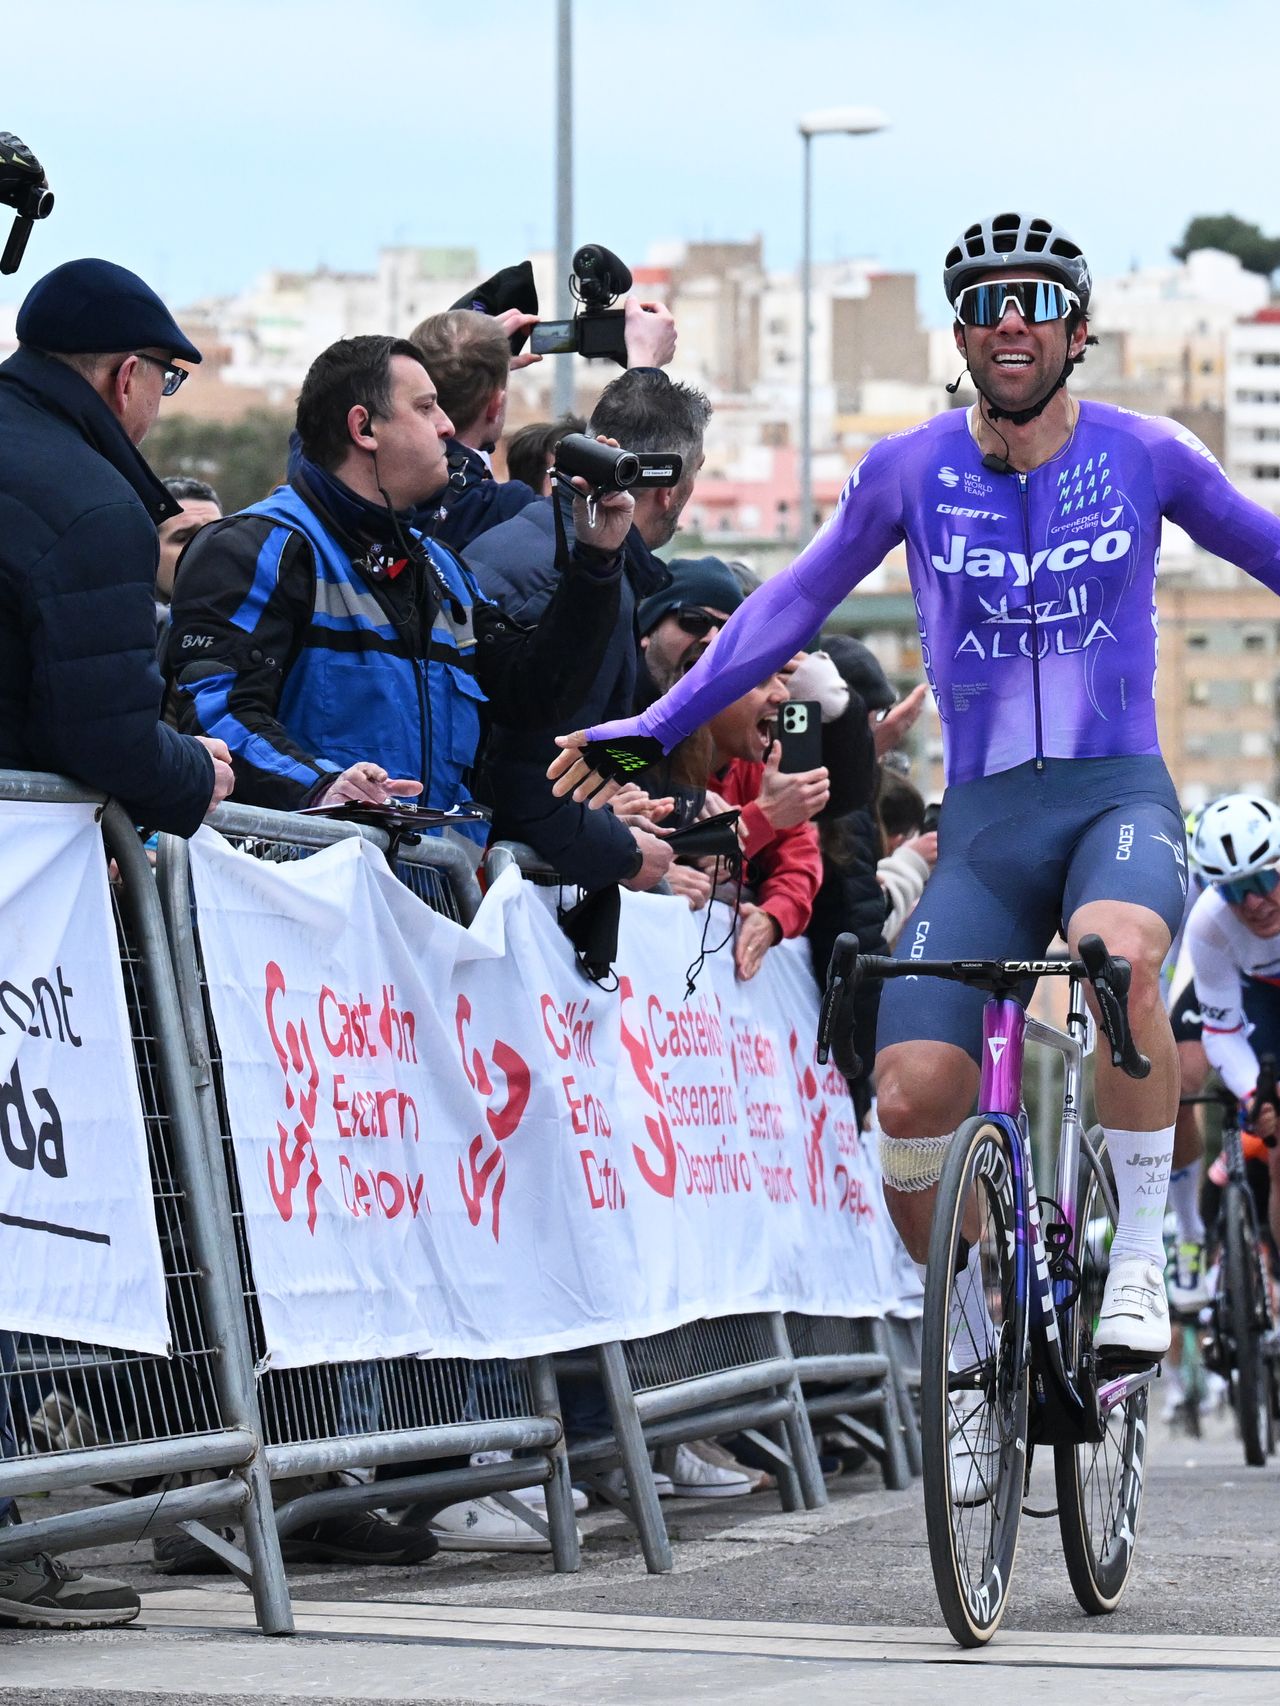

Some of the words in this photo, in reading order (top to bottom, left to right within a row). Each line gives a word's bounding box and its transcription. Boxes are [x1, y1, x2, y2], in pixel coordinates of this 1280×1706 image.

[964, 472, 981, 482] UCI
[1057, 452, 1107, 487] MAAP
[964, 479, 993, 493] WORLD
[964, 486, 985, 497] TEAM
[1059, 469, 1110, 501] MAAP
[1061, 485, 1112, 517] MAAP
[936, 503, 1008, 520] GIANT
[1051, 512, 1100, 534] GreenEDGE
[1071, 520, 1099, 534] cycling
[931, 530, 1132, 587] Jayco
[182, 634, 215, 649] BNF
[953, 618, 1119, 661] ALULA
[1115, 822, 1135, 861] CADEX
[1004, 961, 1073, 973] CADEX
[1126, 1152, 1172, 1169] Jayc
